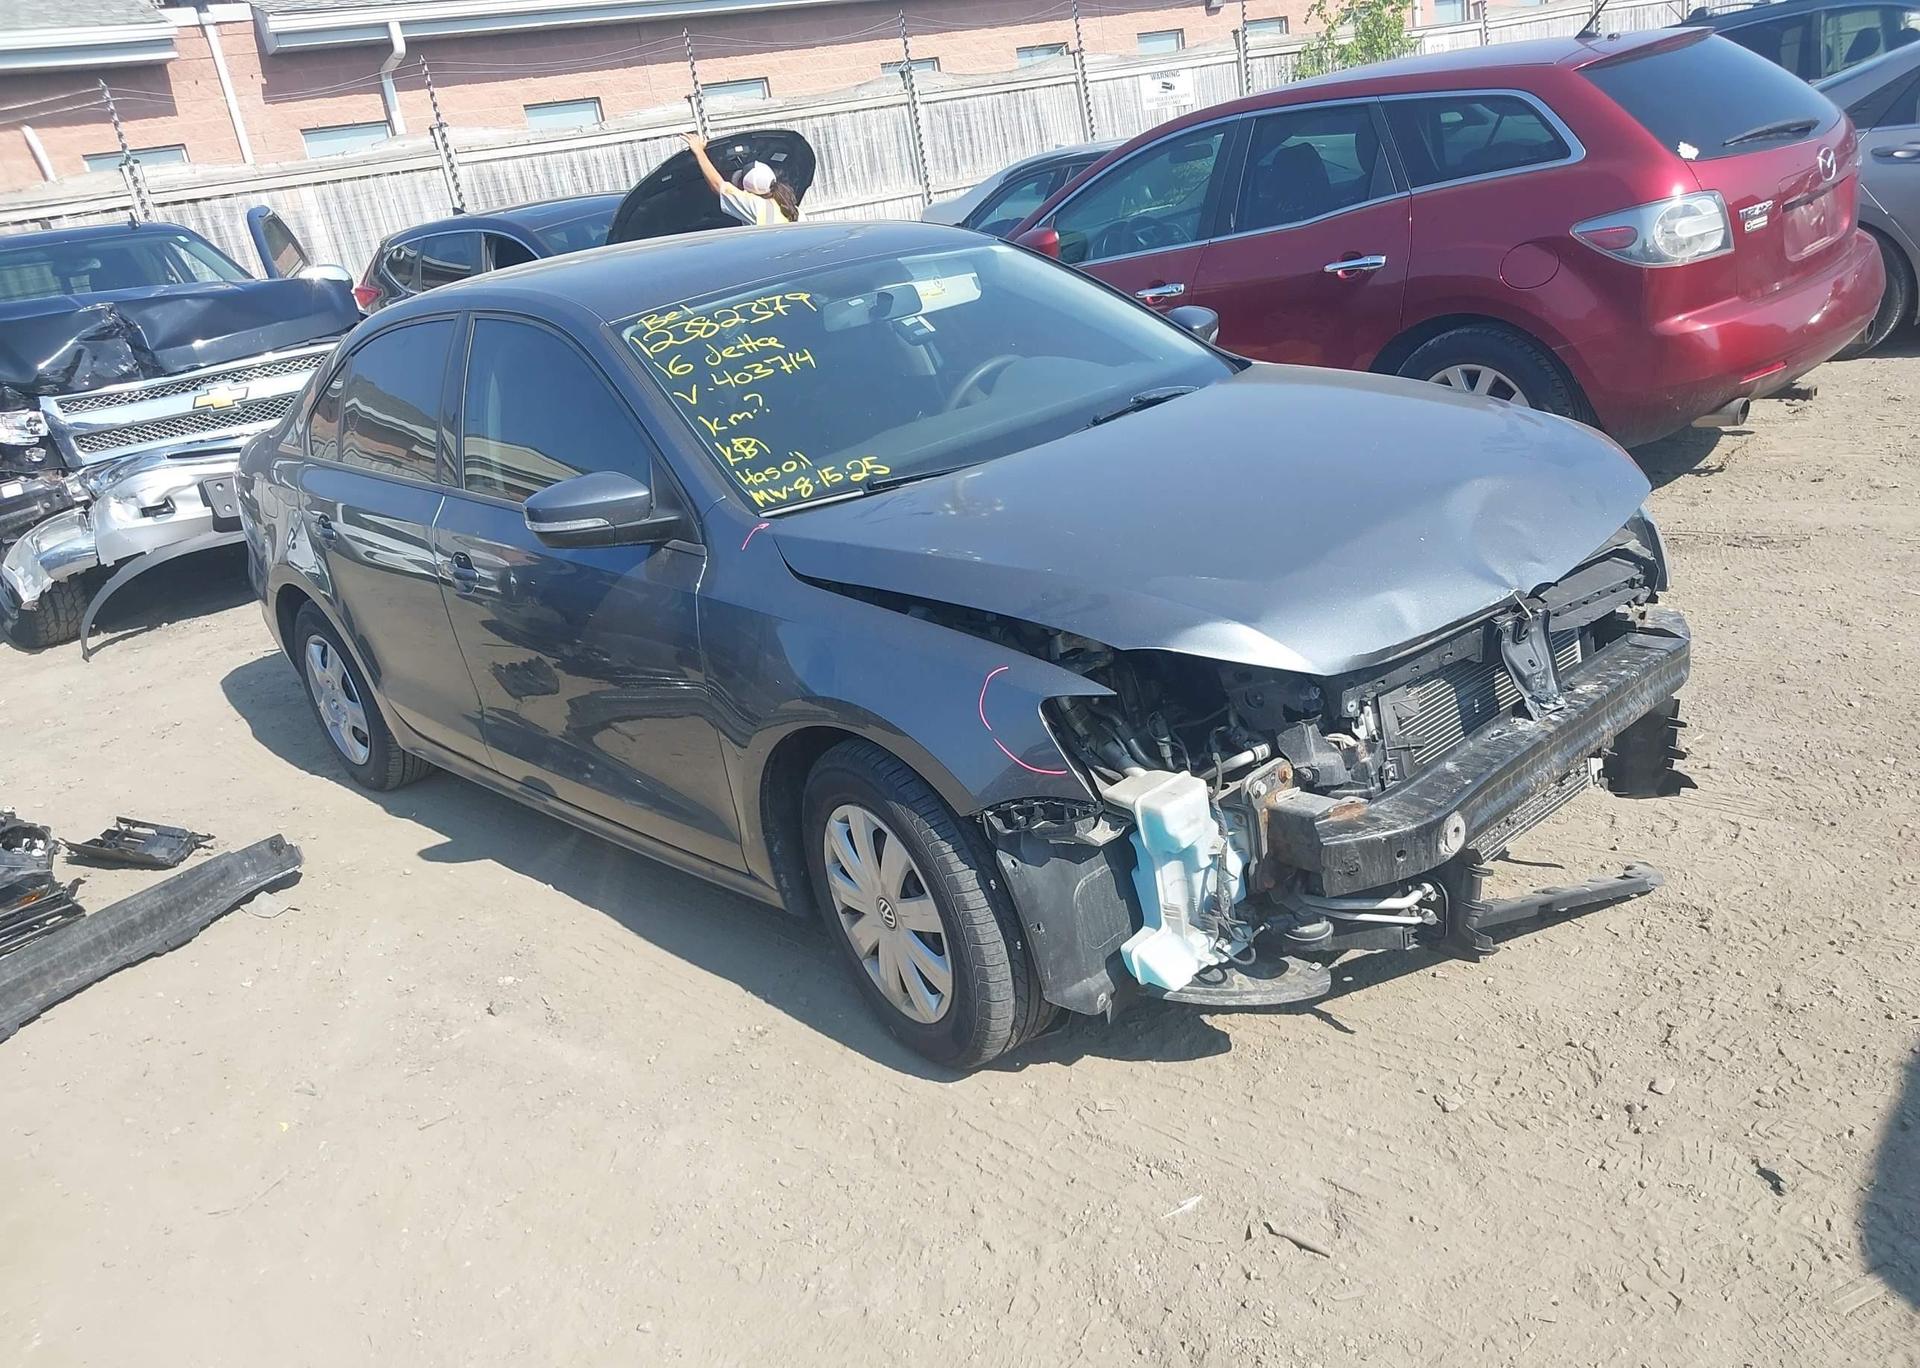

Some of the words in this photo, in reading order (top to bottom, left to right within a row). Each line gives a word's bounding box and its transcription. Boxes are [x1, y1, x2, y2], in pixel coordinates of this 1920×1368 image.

[1150, 70, 1181, 81] WARNING
[630, 292, 817, 359] 12382379
[653, 354, 693, 379] 16
[704, 333, 785, 366] Jetta
